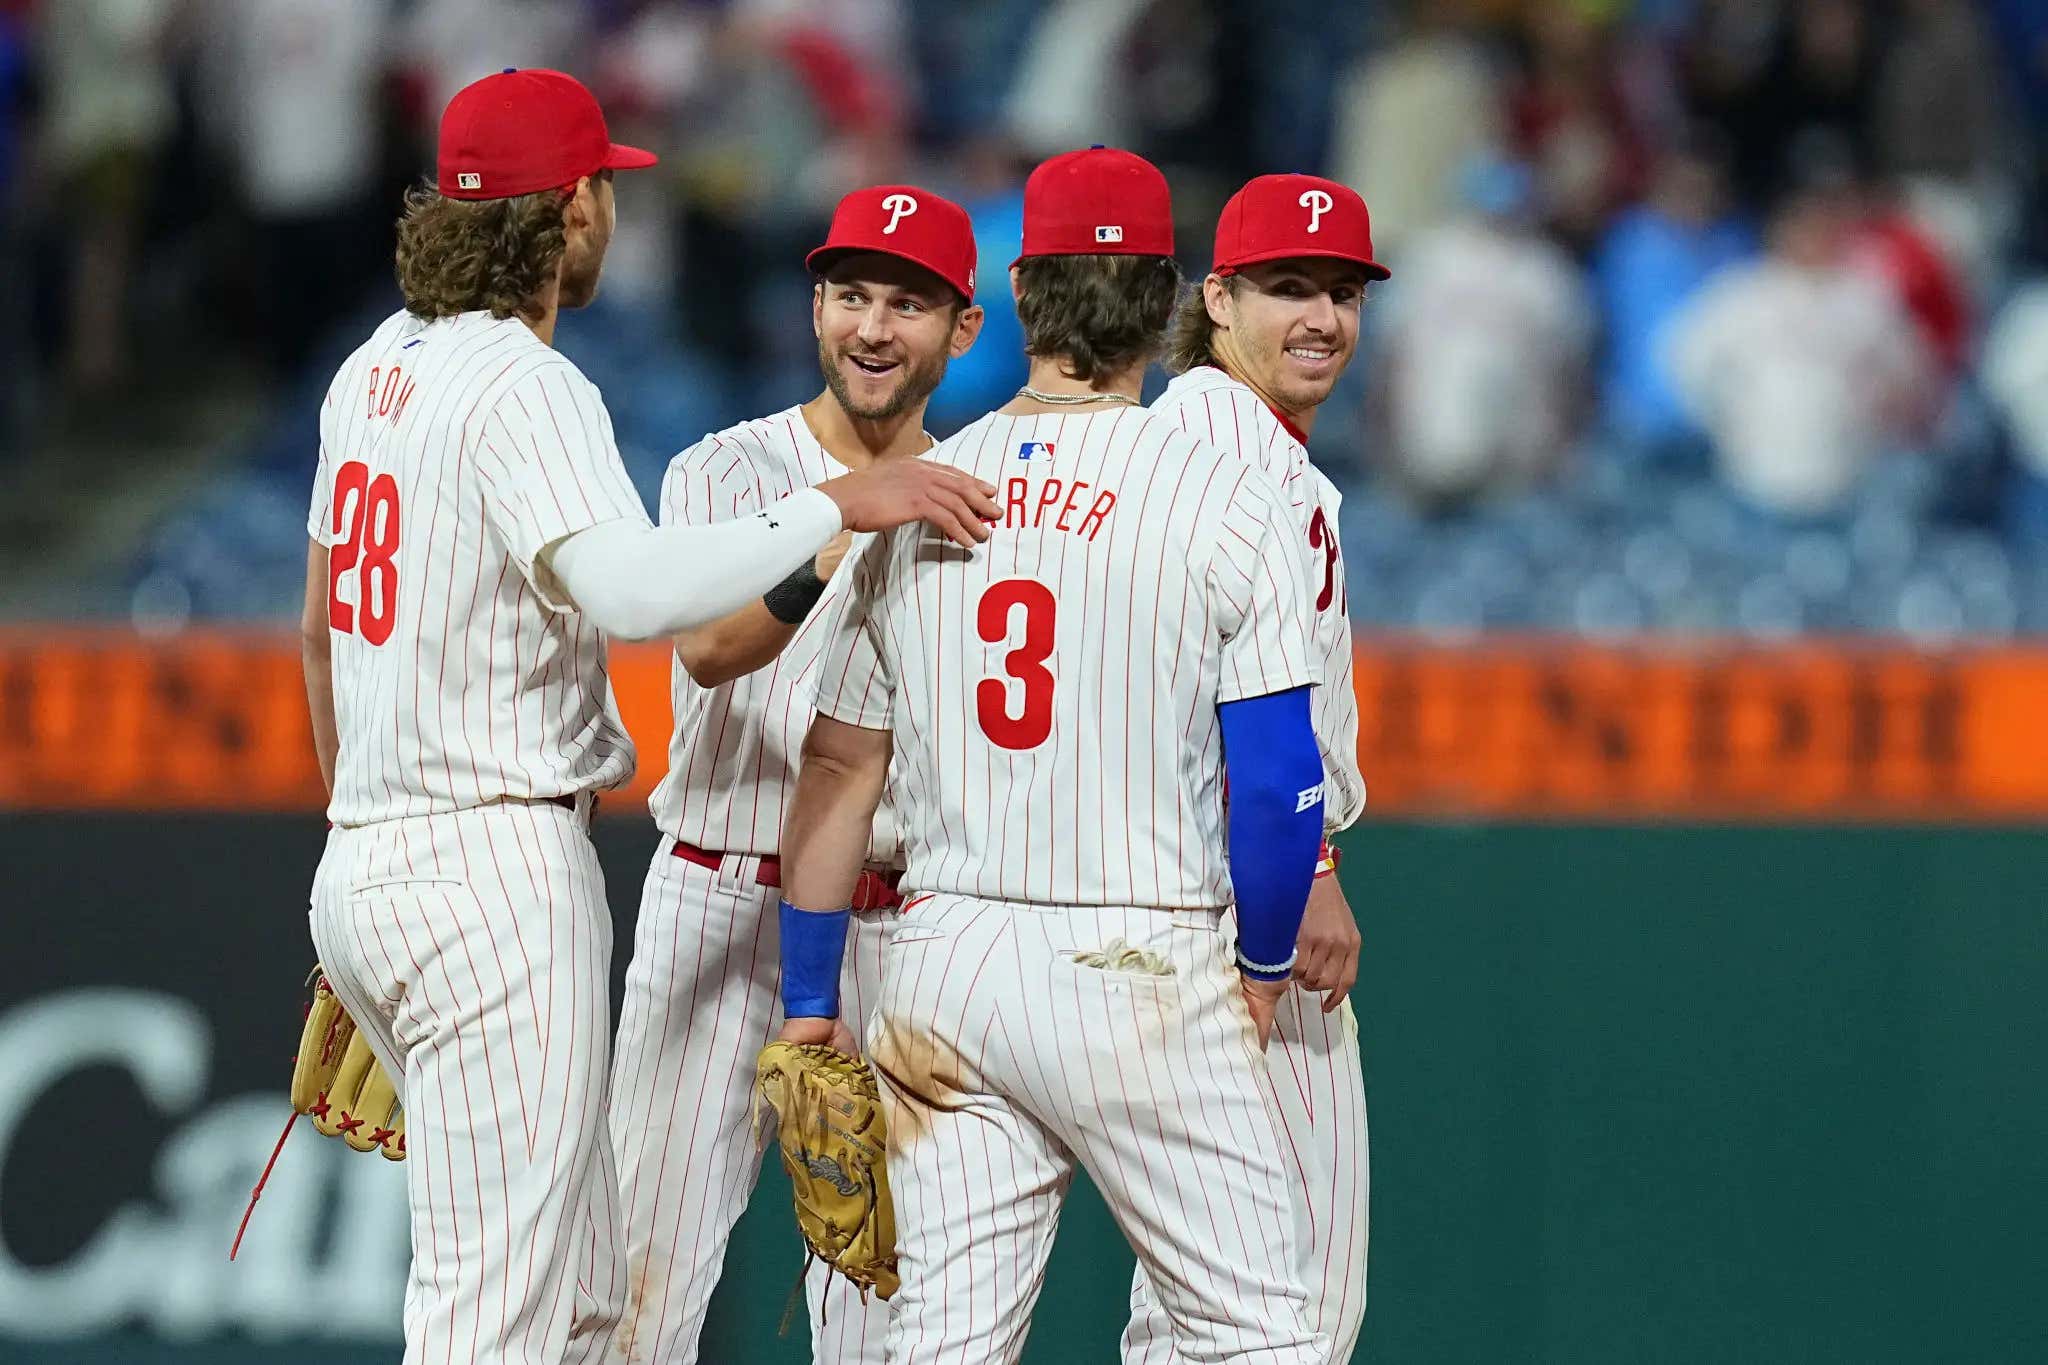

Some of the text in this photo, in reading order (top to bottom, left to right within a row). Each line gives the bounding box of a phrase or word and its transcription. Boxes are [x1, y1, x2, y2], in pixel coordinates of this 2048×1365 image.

[881, 194, 918, 235] P
[1299, 189, 1334, 234] P
[947, 477, 1117, 542] RPER
[329, 461, 400, 646] 28
[976, 579, 1056, 751] 3
